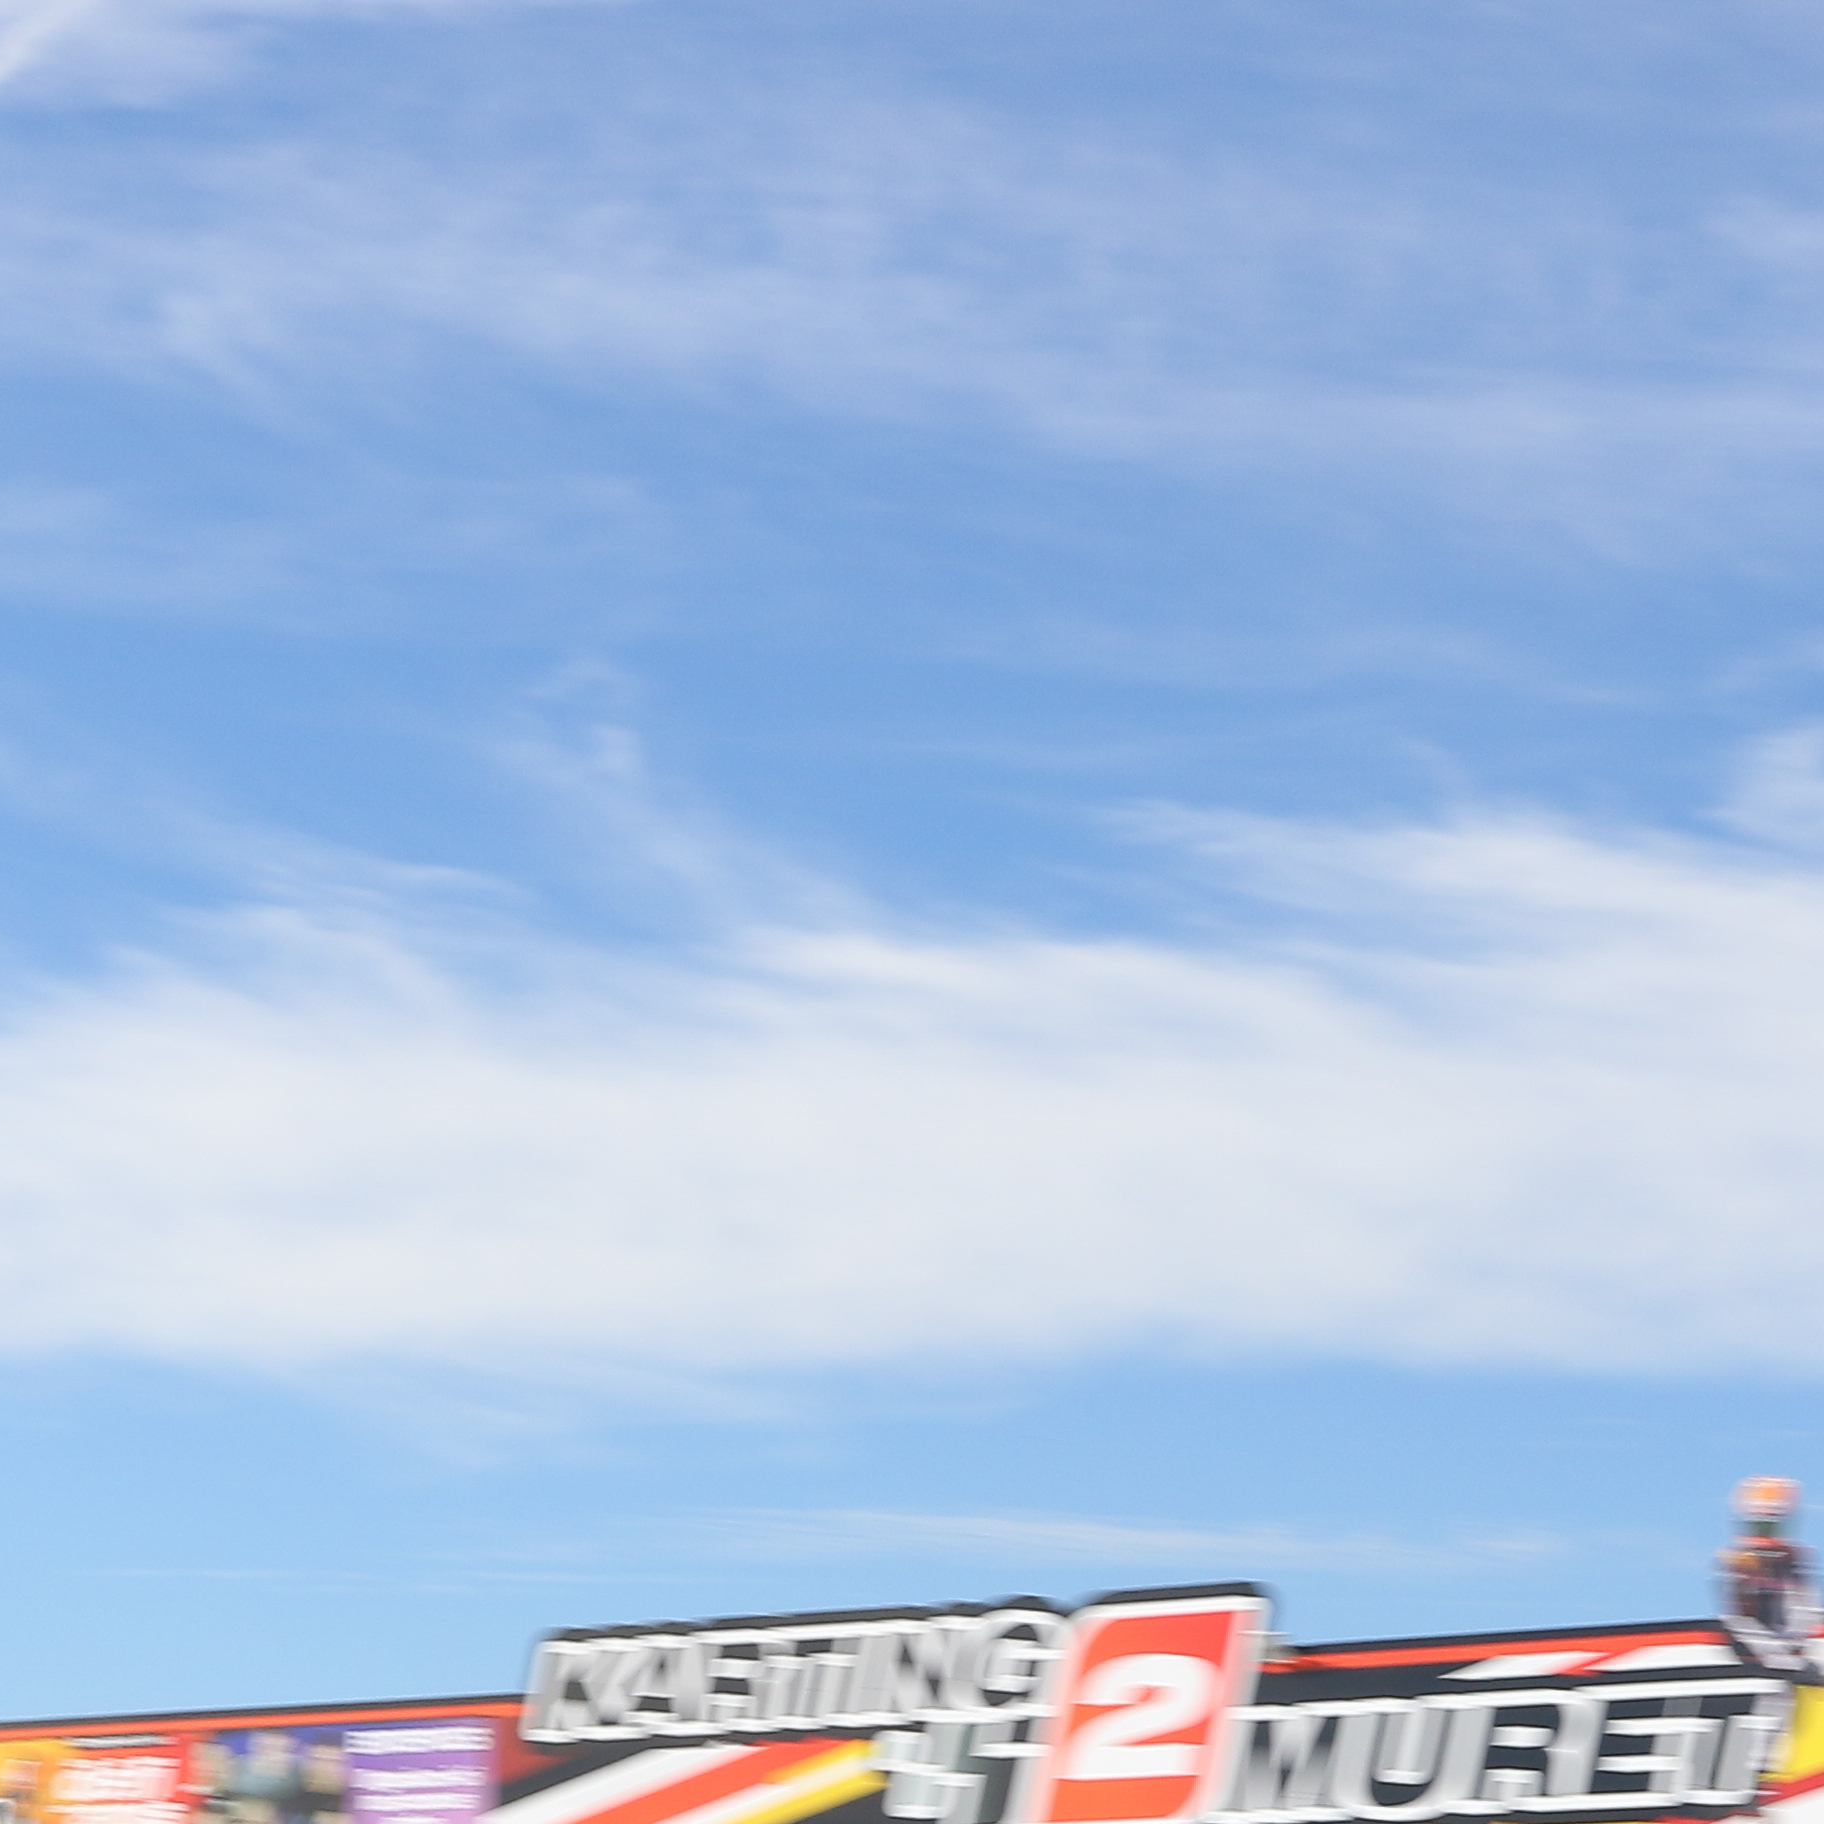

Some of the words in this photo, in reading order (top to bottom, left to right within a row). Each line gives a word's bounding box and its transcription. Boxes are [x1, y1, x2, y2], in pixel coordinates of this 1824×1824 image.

[519, 1608, 1065, 1742] KARTING
[1053, 1653, 1223, 1780] 2
[1204, 1678, 1786, 1824] MURET
